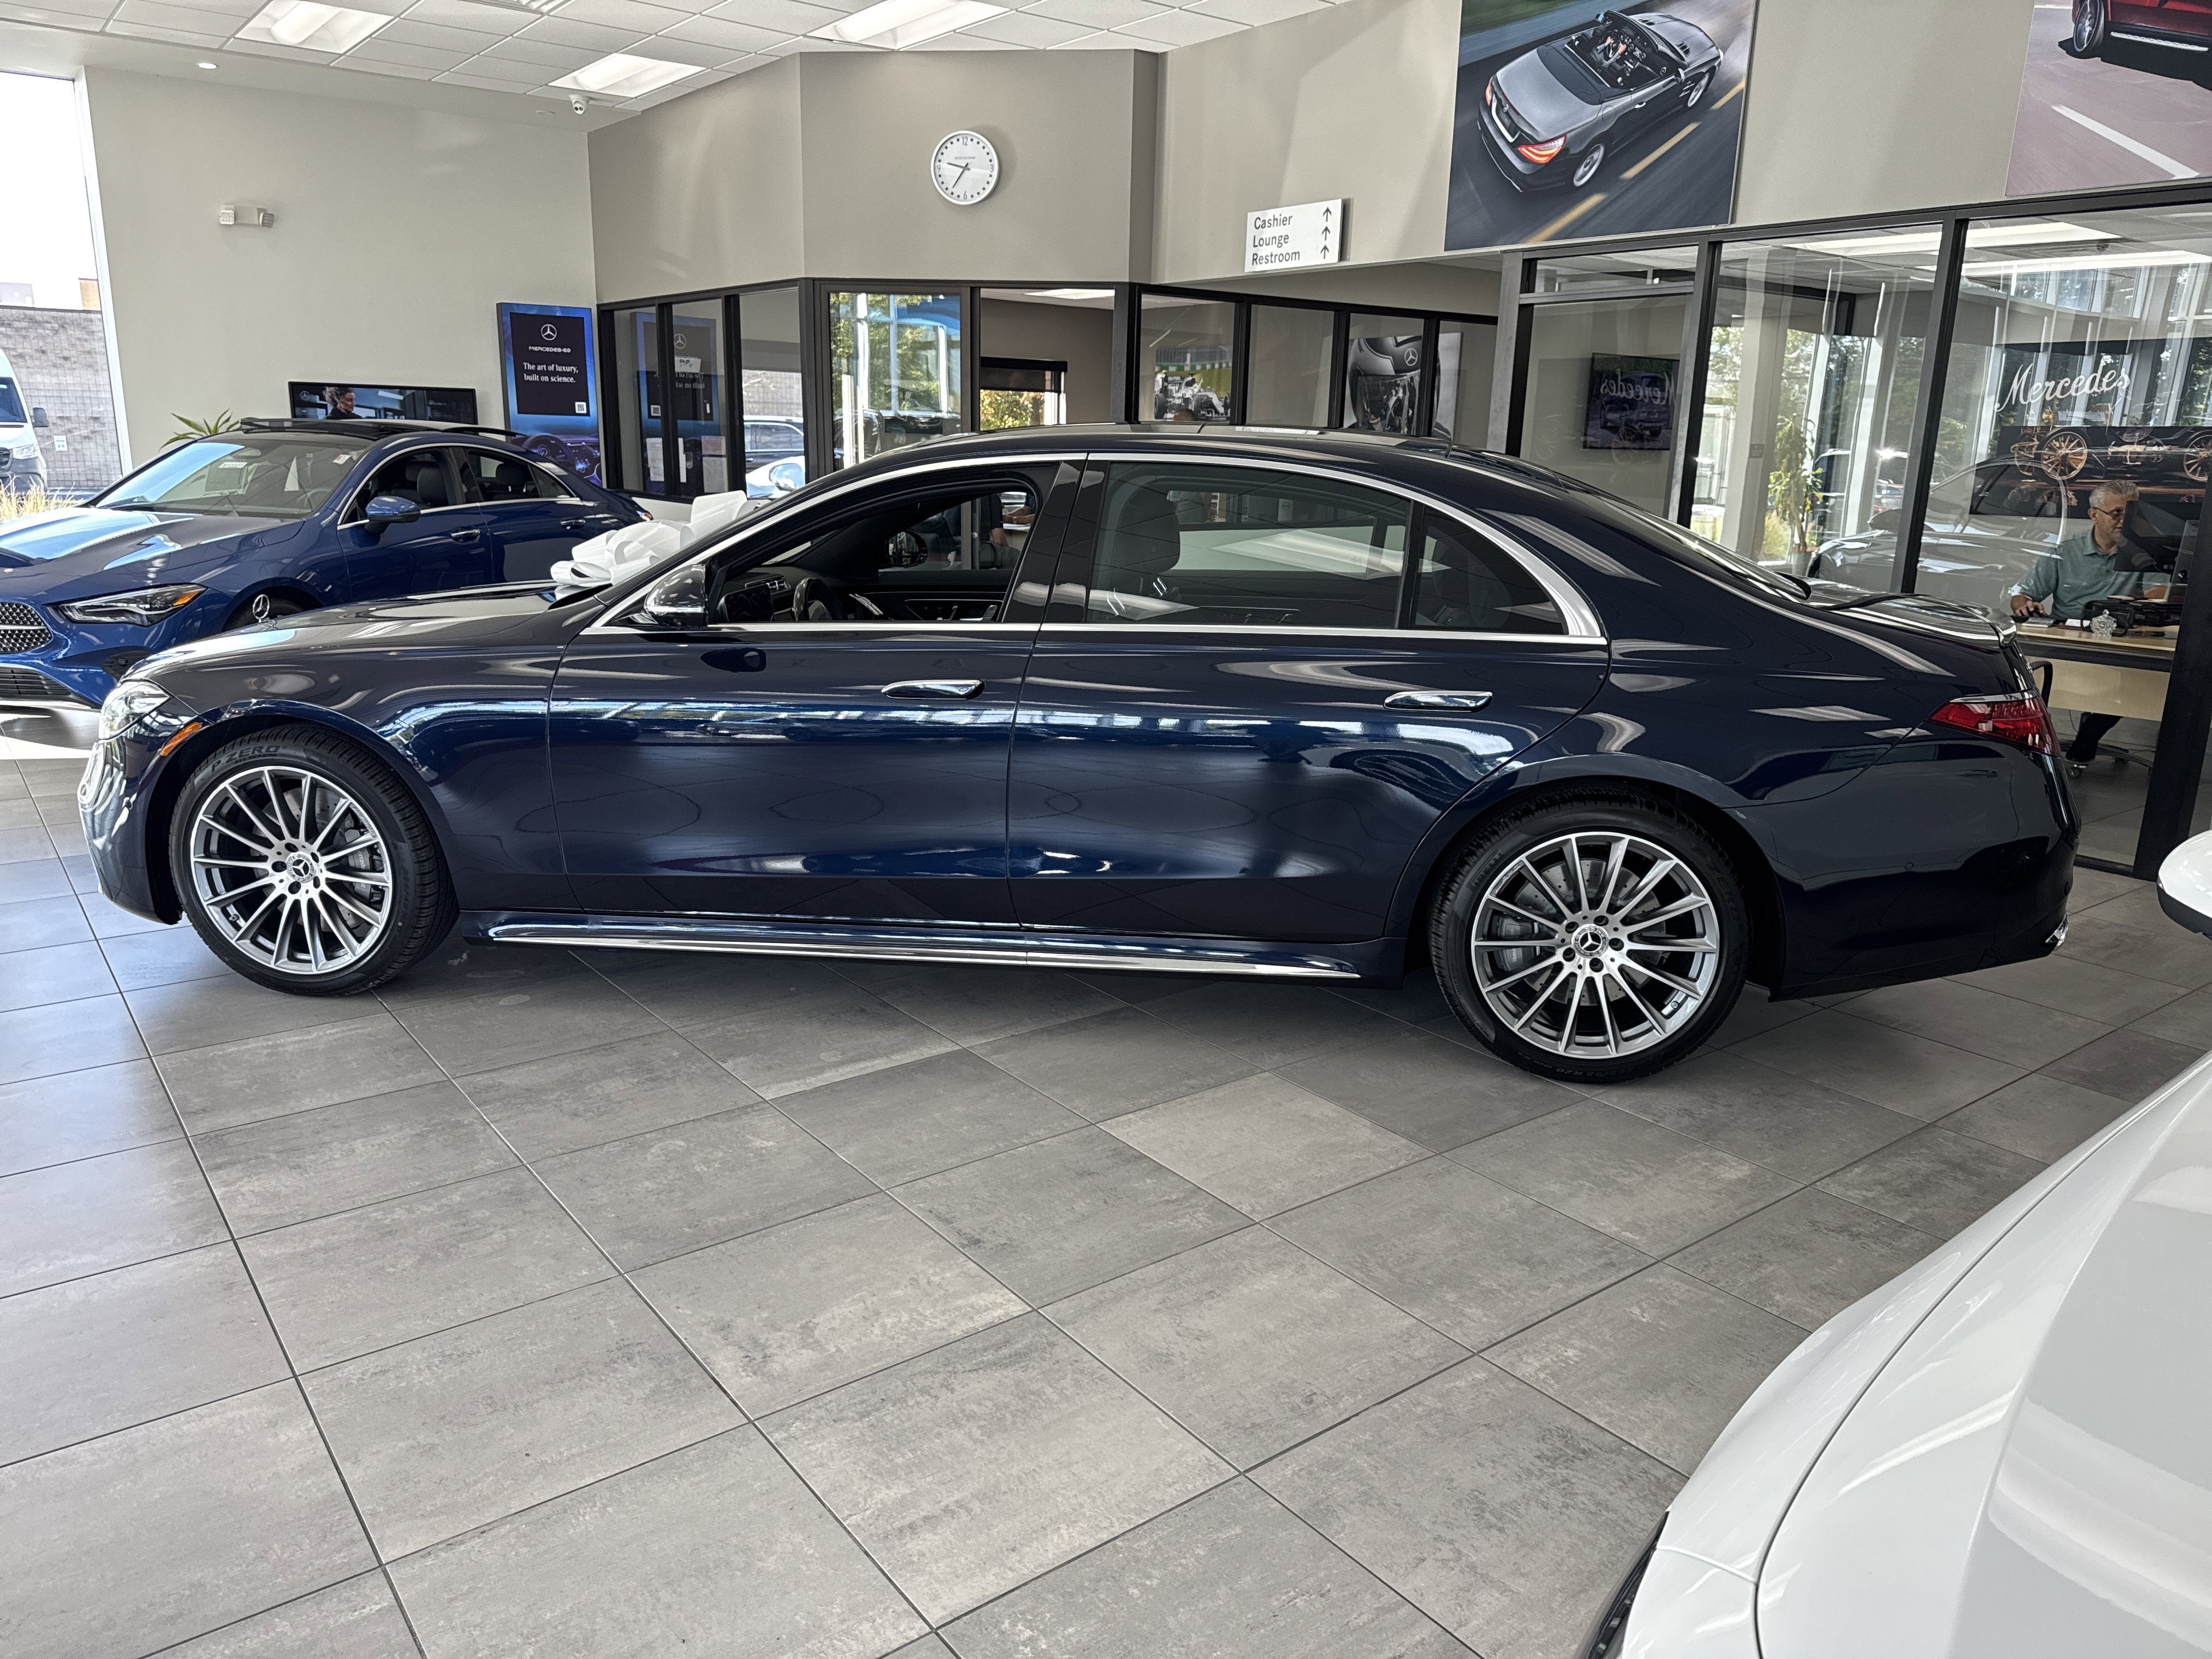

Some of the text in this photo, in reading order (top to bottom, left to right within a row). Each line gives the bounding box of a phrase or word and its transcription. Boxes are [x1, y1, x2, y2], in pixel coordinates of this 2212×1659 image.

[962, 136, 968, 145] 12
[937, 164, 941, 173] 9
[990, 164, 994, 173] 3
[963, 190, 967, 200] 6
[1254, 213, 1293, 230] Cashier
[1253, 234, 1289, 249] Lounge
[1251, 250, 1300, 266] Restroom
[523, 362, 579, 375] The art of luxury,
[523, 373, 539, 382] built
[550, 375, 576, 383] science.
[1994, 358, 2130, 412] Mercedes
[211, 745, 281, 773] P ZERO
